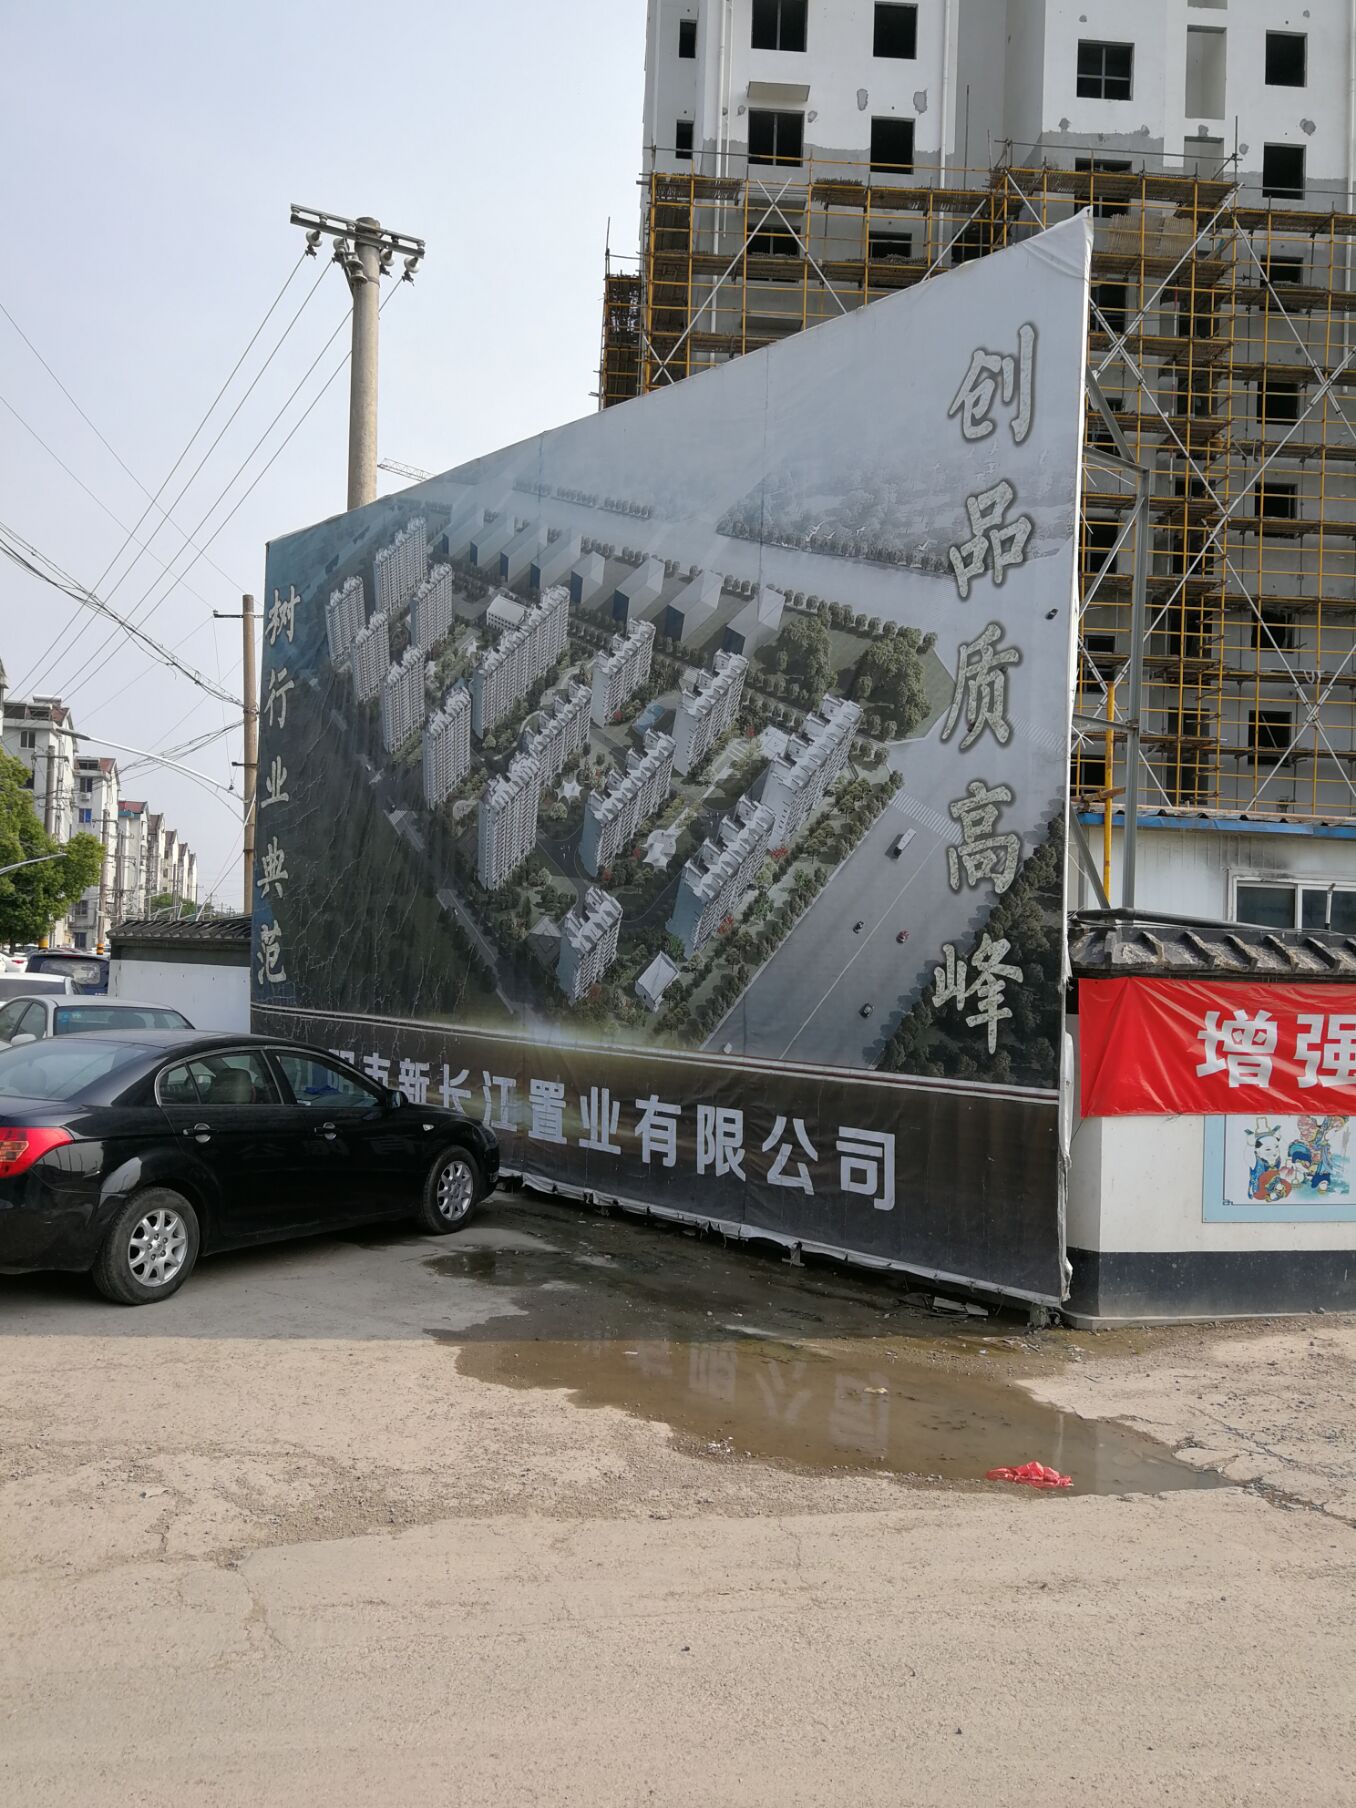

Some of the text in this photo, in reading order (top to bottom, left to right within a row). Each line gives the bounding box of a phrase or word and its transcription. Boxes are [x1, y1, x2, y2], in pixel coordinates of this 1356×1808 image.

[256, 585, 301, 986] 树行业典范
[931, 323, 1038, 1056] 创品质高峰
[1195, 1008, 1356, 1089] 增强
